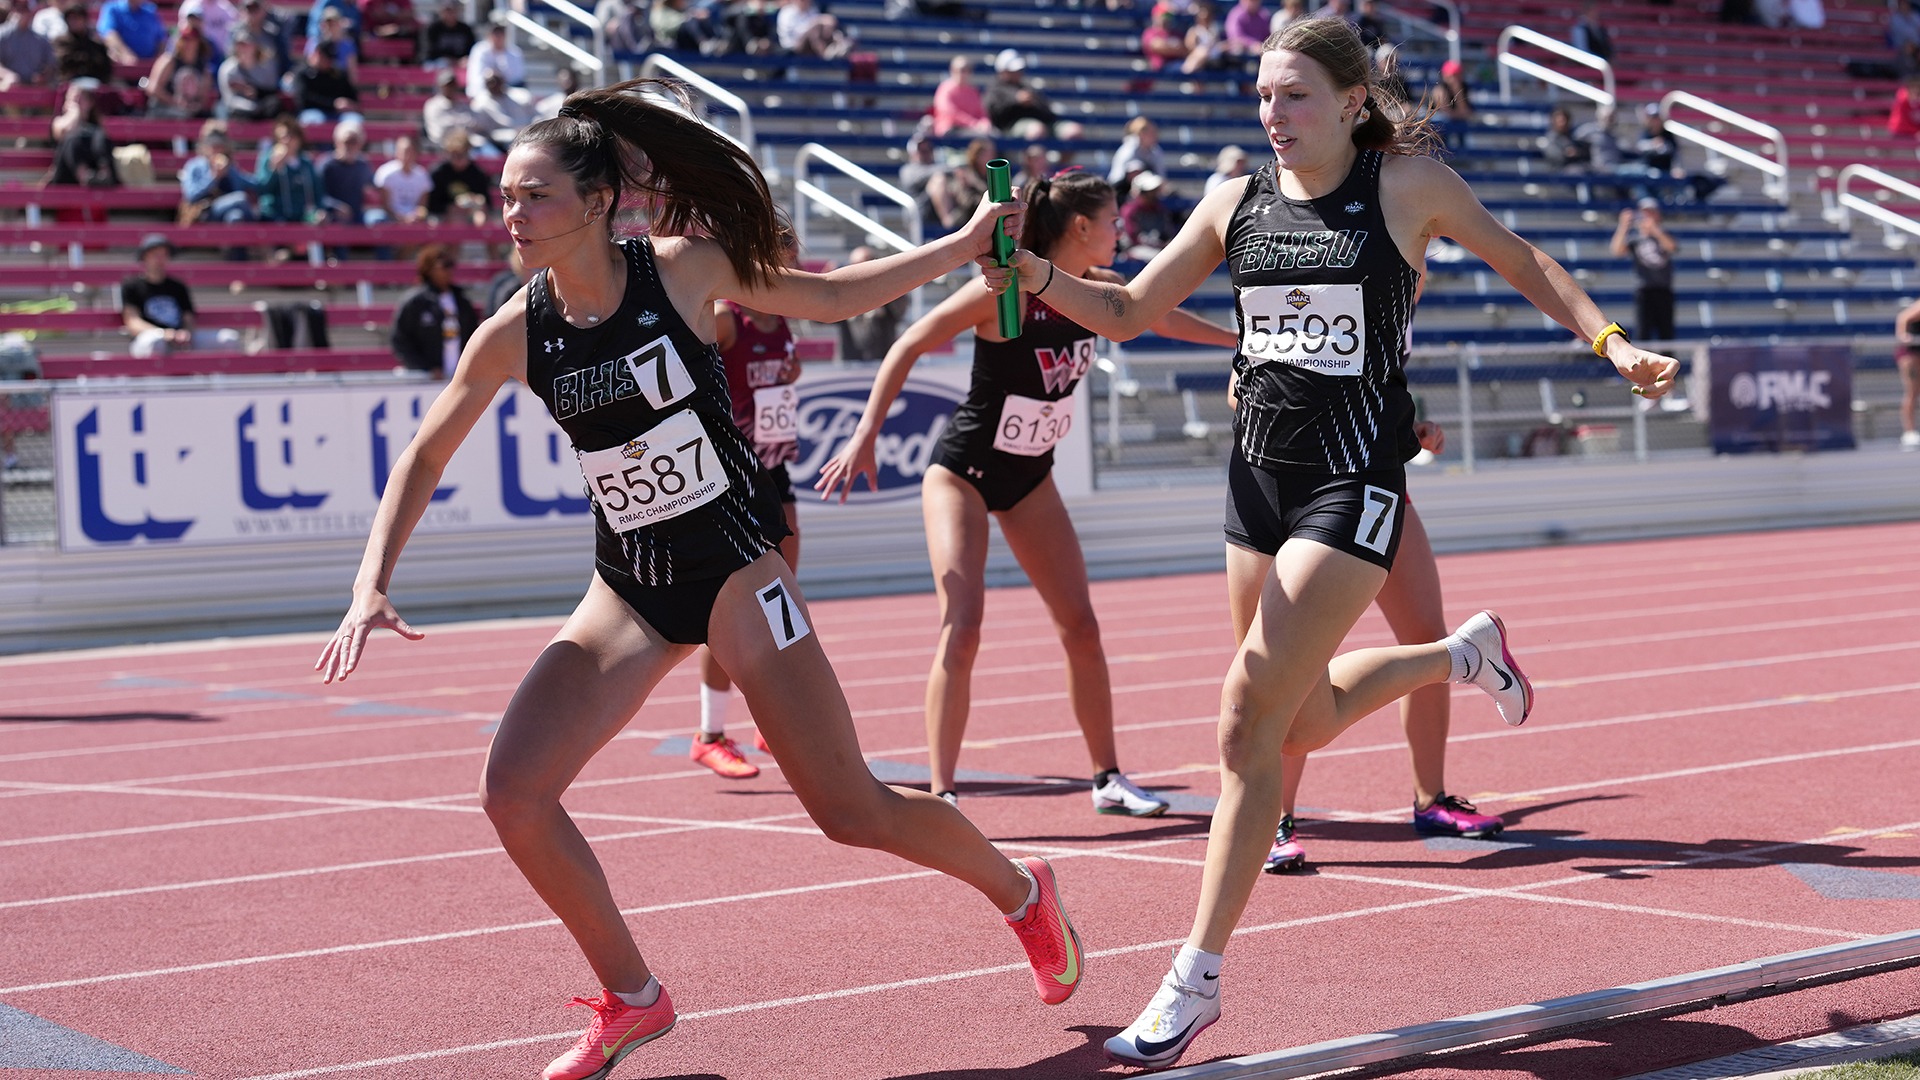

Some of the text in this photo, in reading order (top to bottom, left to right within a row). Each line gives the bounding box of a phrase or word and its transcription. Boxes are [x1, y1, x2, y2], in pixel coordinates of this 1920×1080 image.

[1239, 230, 1368, 273] BHSU
[1287, 294, 1311, 304] RMAC
[1248, 314, 1360, 356] 5593
[632, 342, 674, 403] 7
[1077, 342, 1091, 376] 8
[553, 355, 642, 421] BHS
[621, 441, 648, 458] RMAC
[1003, 414, 1072, 443] 6130
[596, 436, 703, 512] 5587
[619, 482, 716, 525] RMAC CHAMPIONSHIP
[1365, 490, 1394, 545] 7
[762, 583, 796, 642] 7
